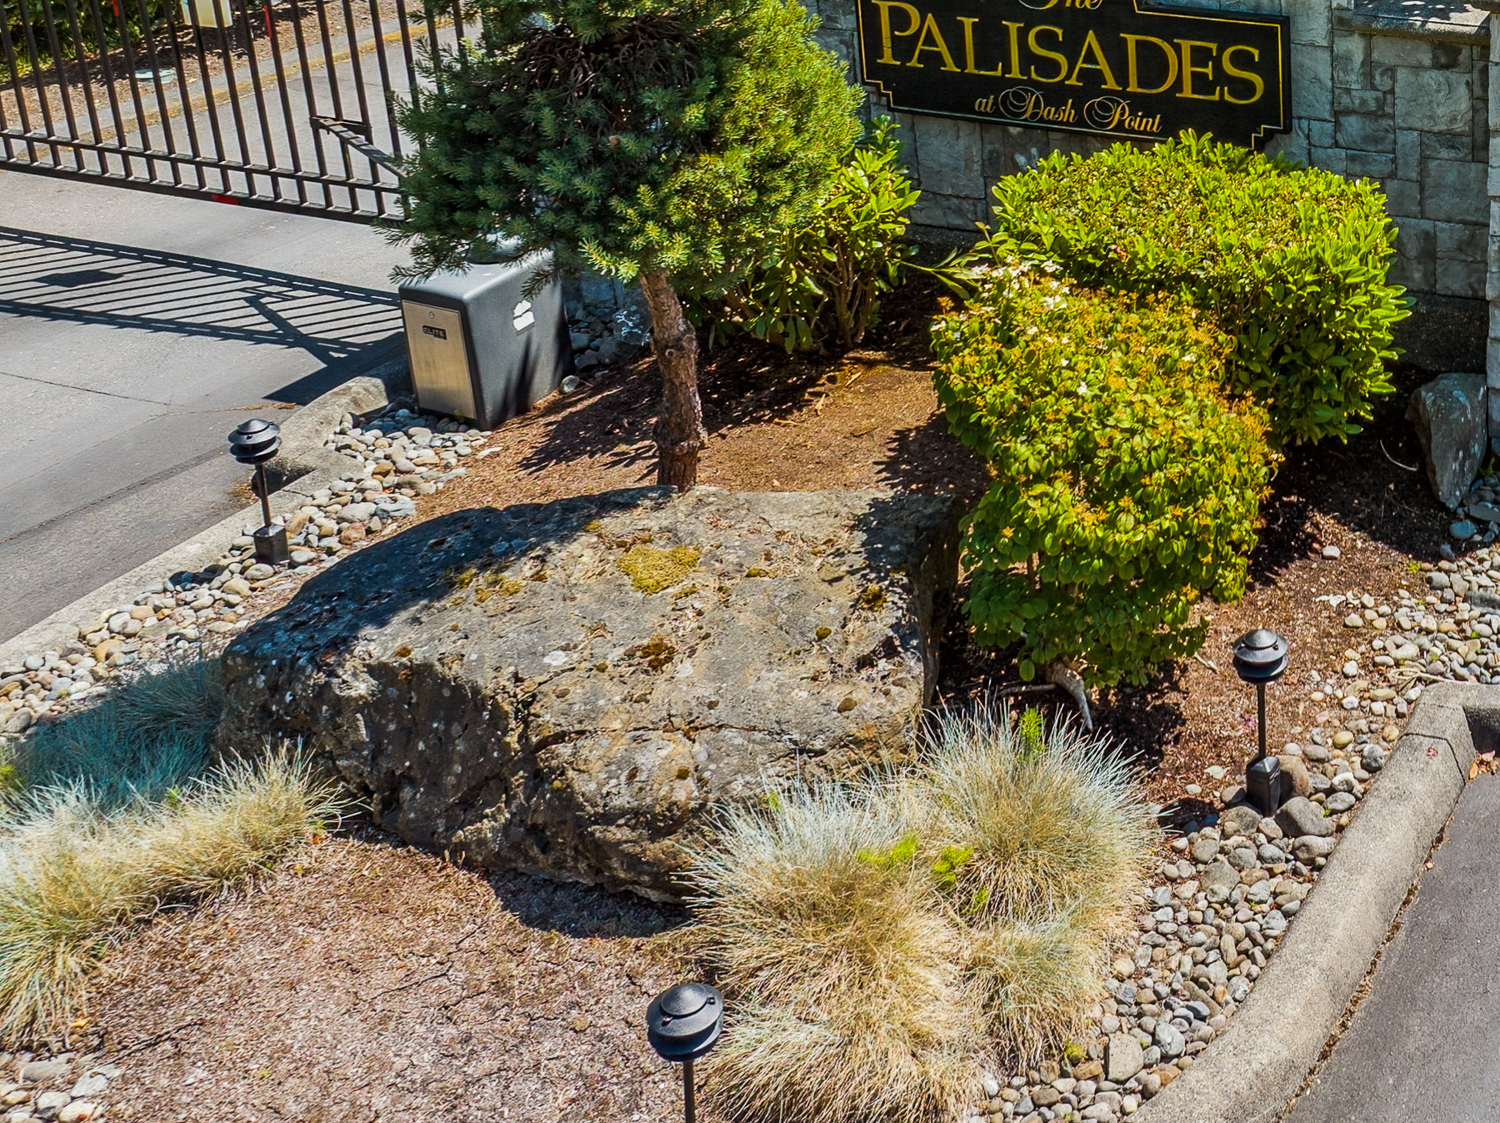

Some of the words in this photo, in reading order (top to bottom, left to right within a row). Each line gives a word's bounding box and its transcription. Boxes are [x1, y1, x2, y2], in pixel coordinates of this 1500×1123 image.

[871, 0, 1265, 105] PALISADES
[974, 95, 997, 114] at
[998, 85, 1079, 123] Dash
[1083, 95, 1163, 133] Point
